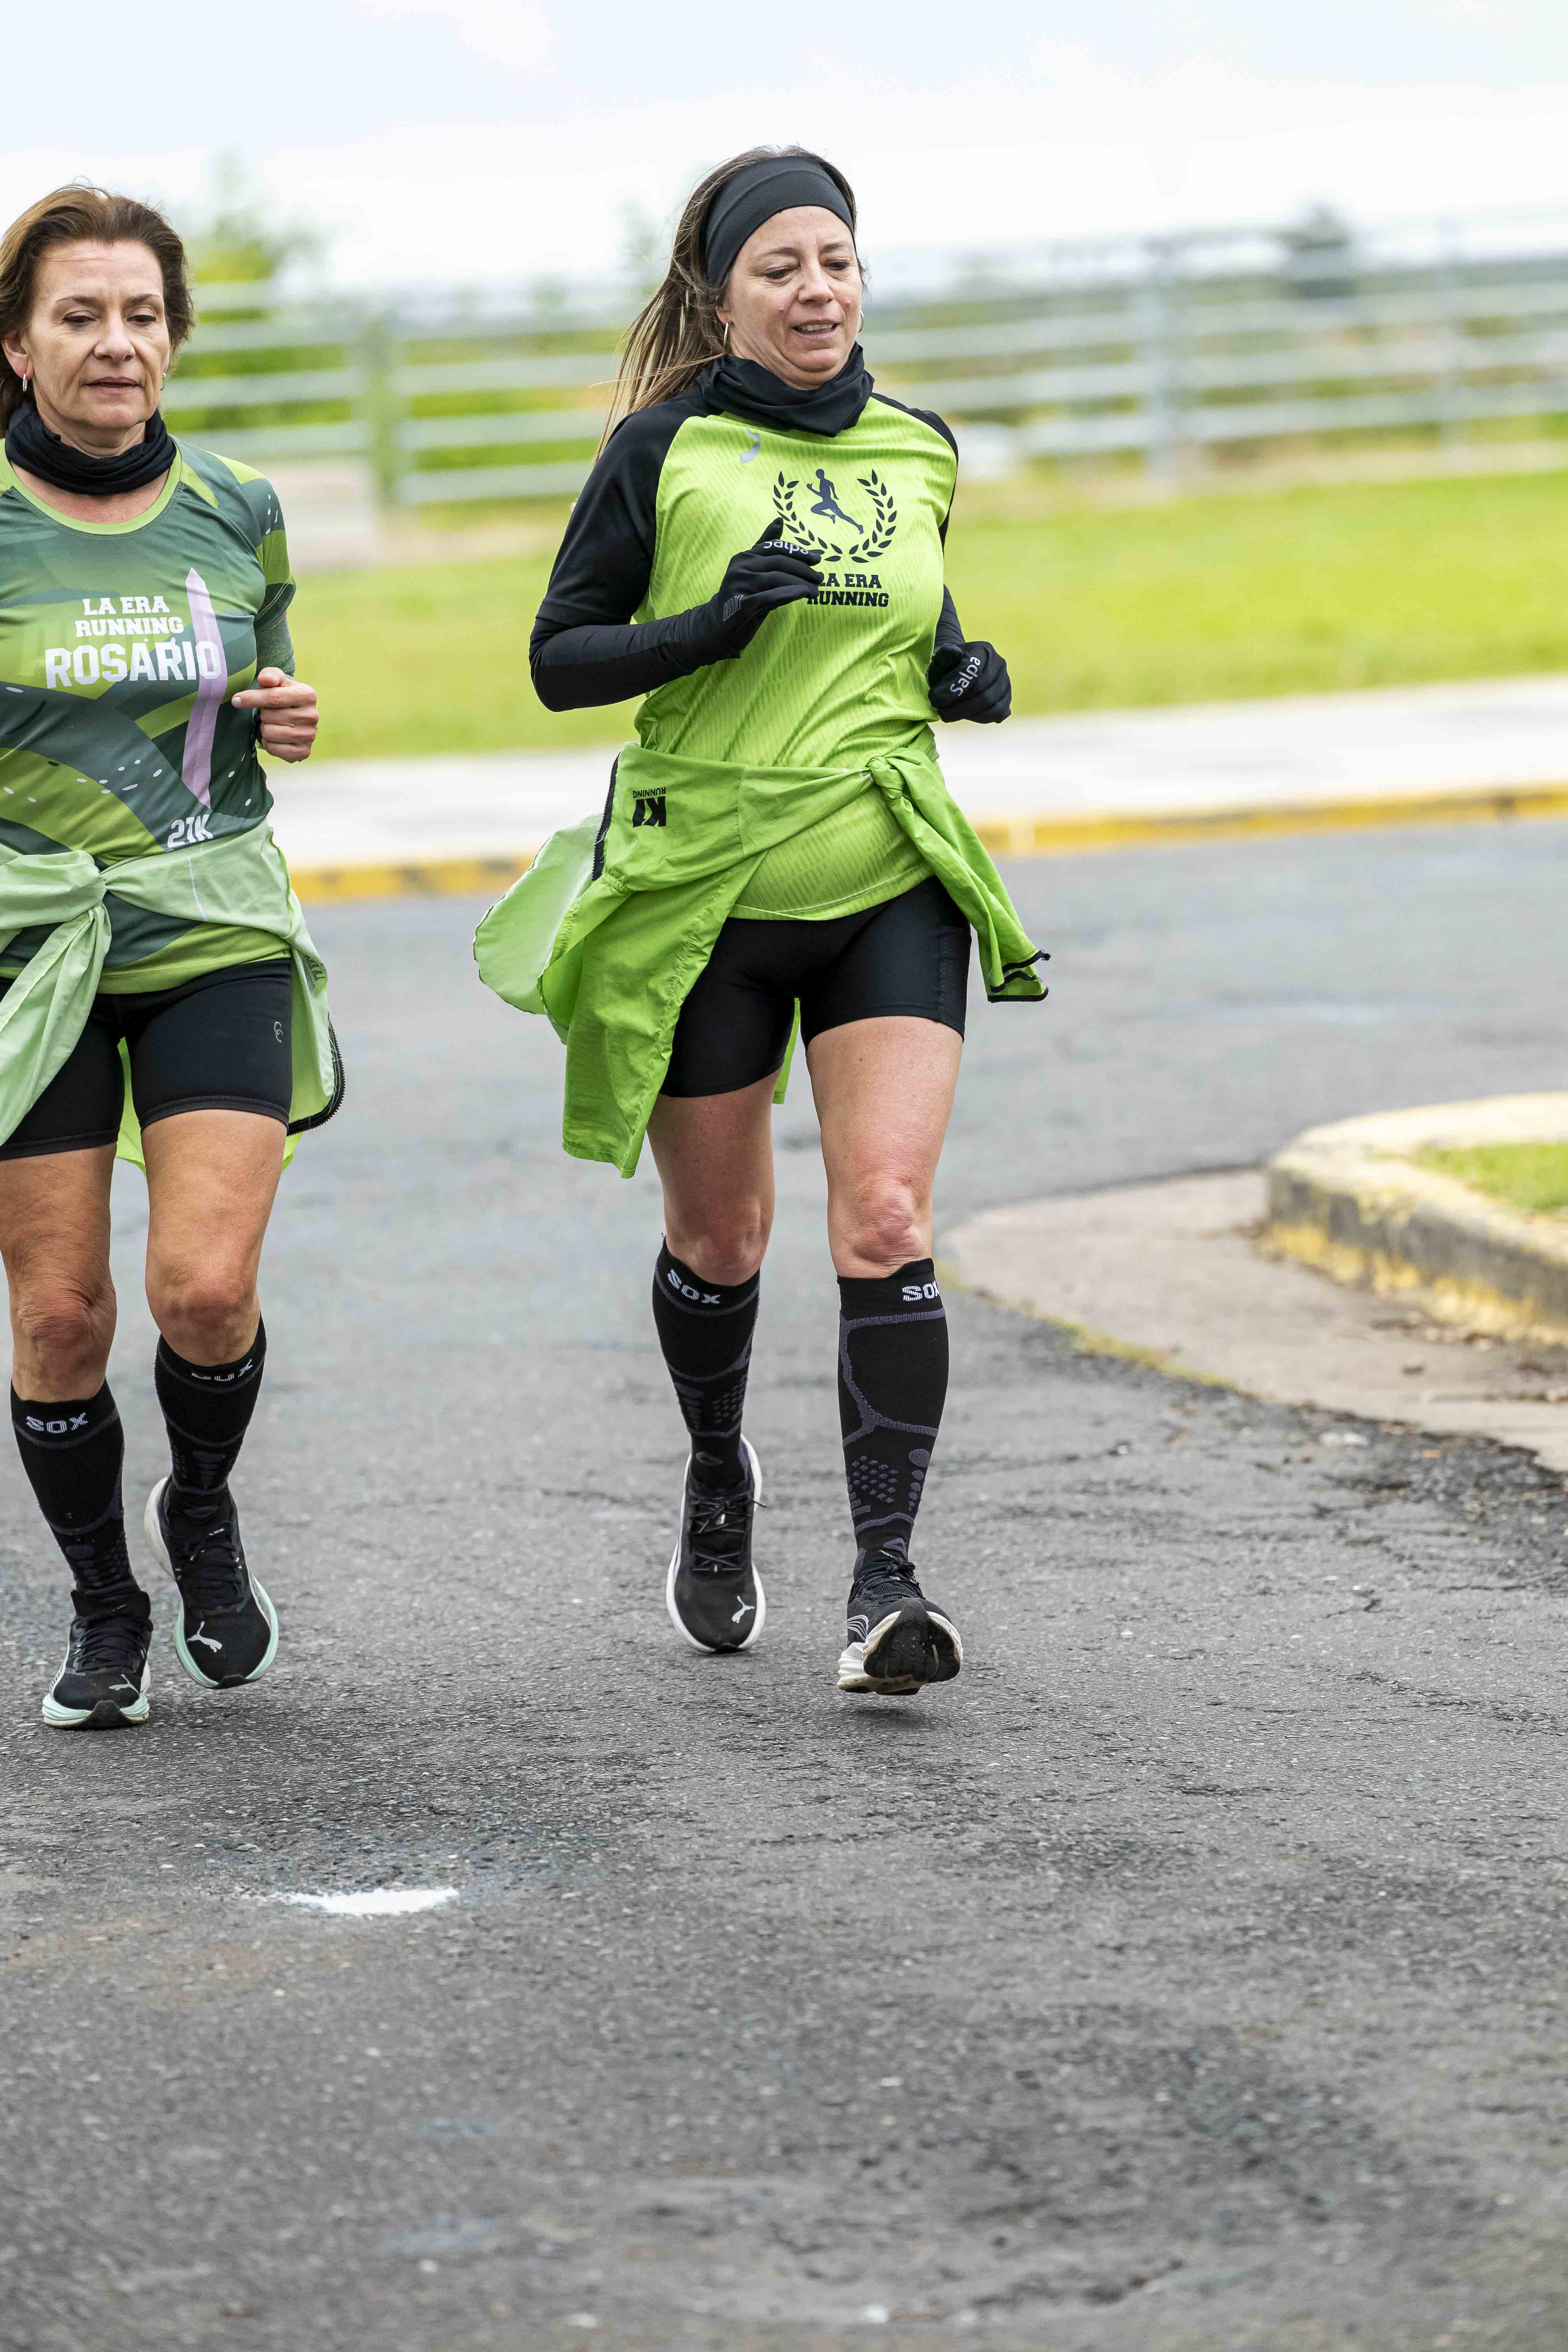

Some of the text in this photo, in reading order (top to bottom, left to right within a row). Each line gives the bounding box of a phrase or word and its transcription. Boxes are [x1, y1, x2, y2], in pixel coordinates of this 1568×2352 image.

[844, 573, 882, 589] ERA
[82, 595, 170, 616] LA ERA
[75, 616, 184, 637] RUNNING
[45, 640, 221, 689] ROSARIO
[950, 656, 981, 696] Salpa
[632, 787, 666, 798] RUNNING
[167, 814, 214, 848] 21K
[667, 1269, 721, 1304] SOX
[26, 1412, 89, 1434] SOX
